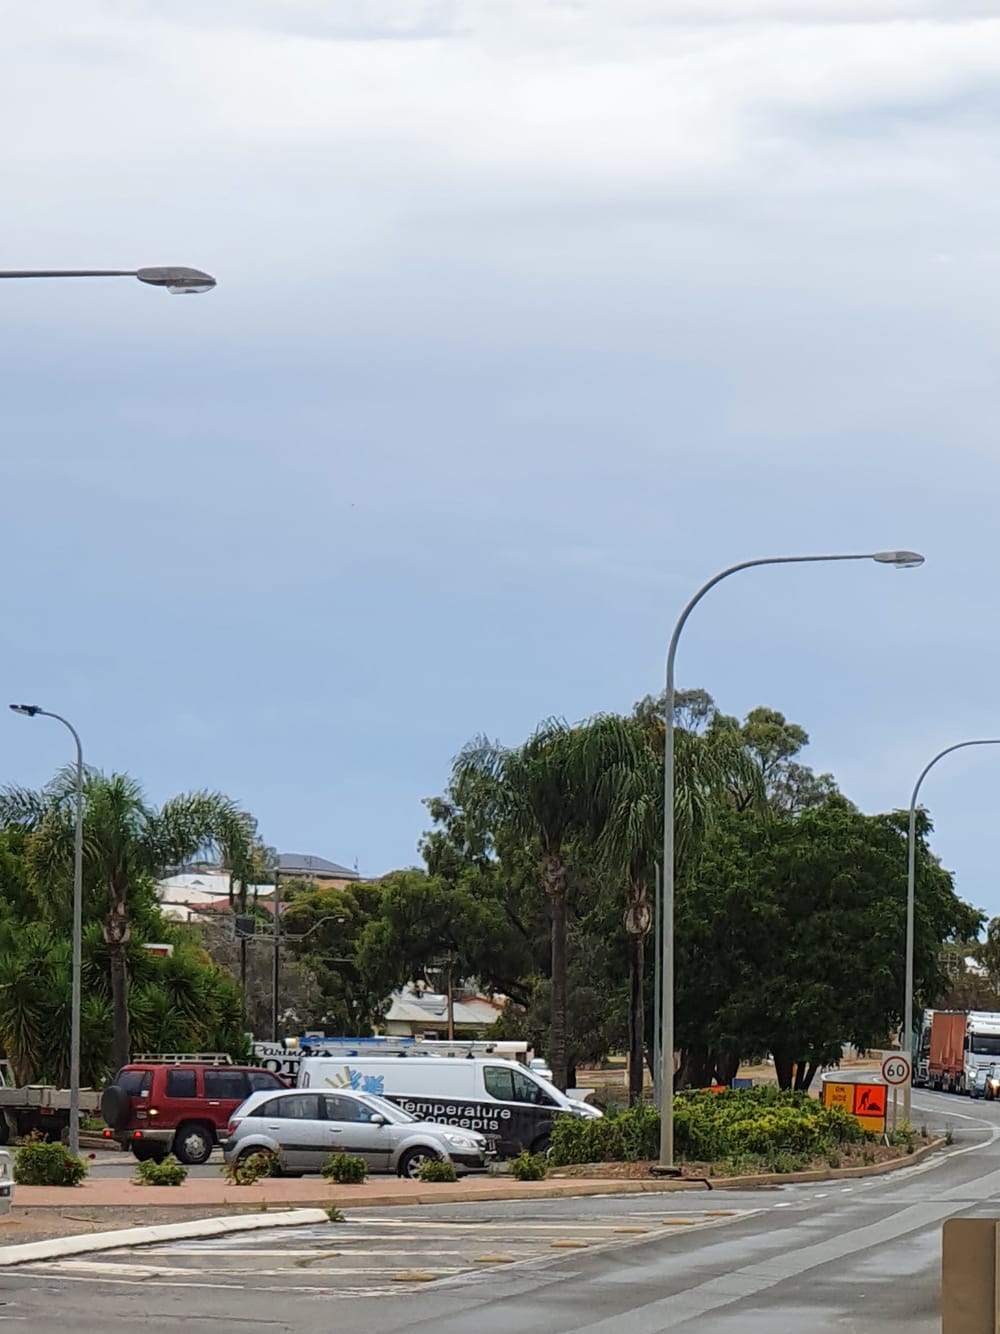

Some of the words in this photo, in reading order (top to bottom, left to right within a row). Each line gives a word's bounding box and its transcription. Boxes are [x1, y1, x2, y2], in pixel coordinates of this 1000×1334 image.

[887, 1064, 904, 1077] 60
[397, 1098, 511, 1119] Temperature
[413, 1111, 498, 1131] Concepts
